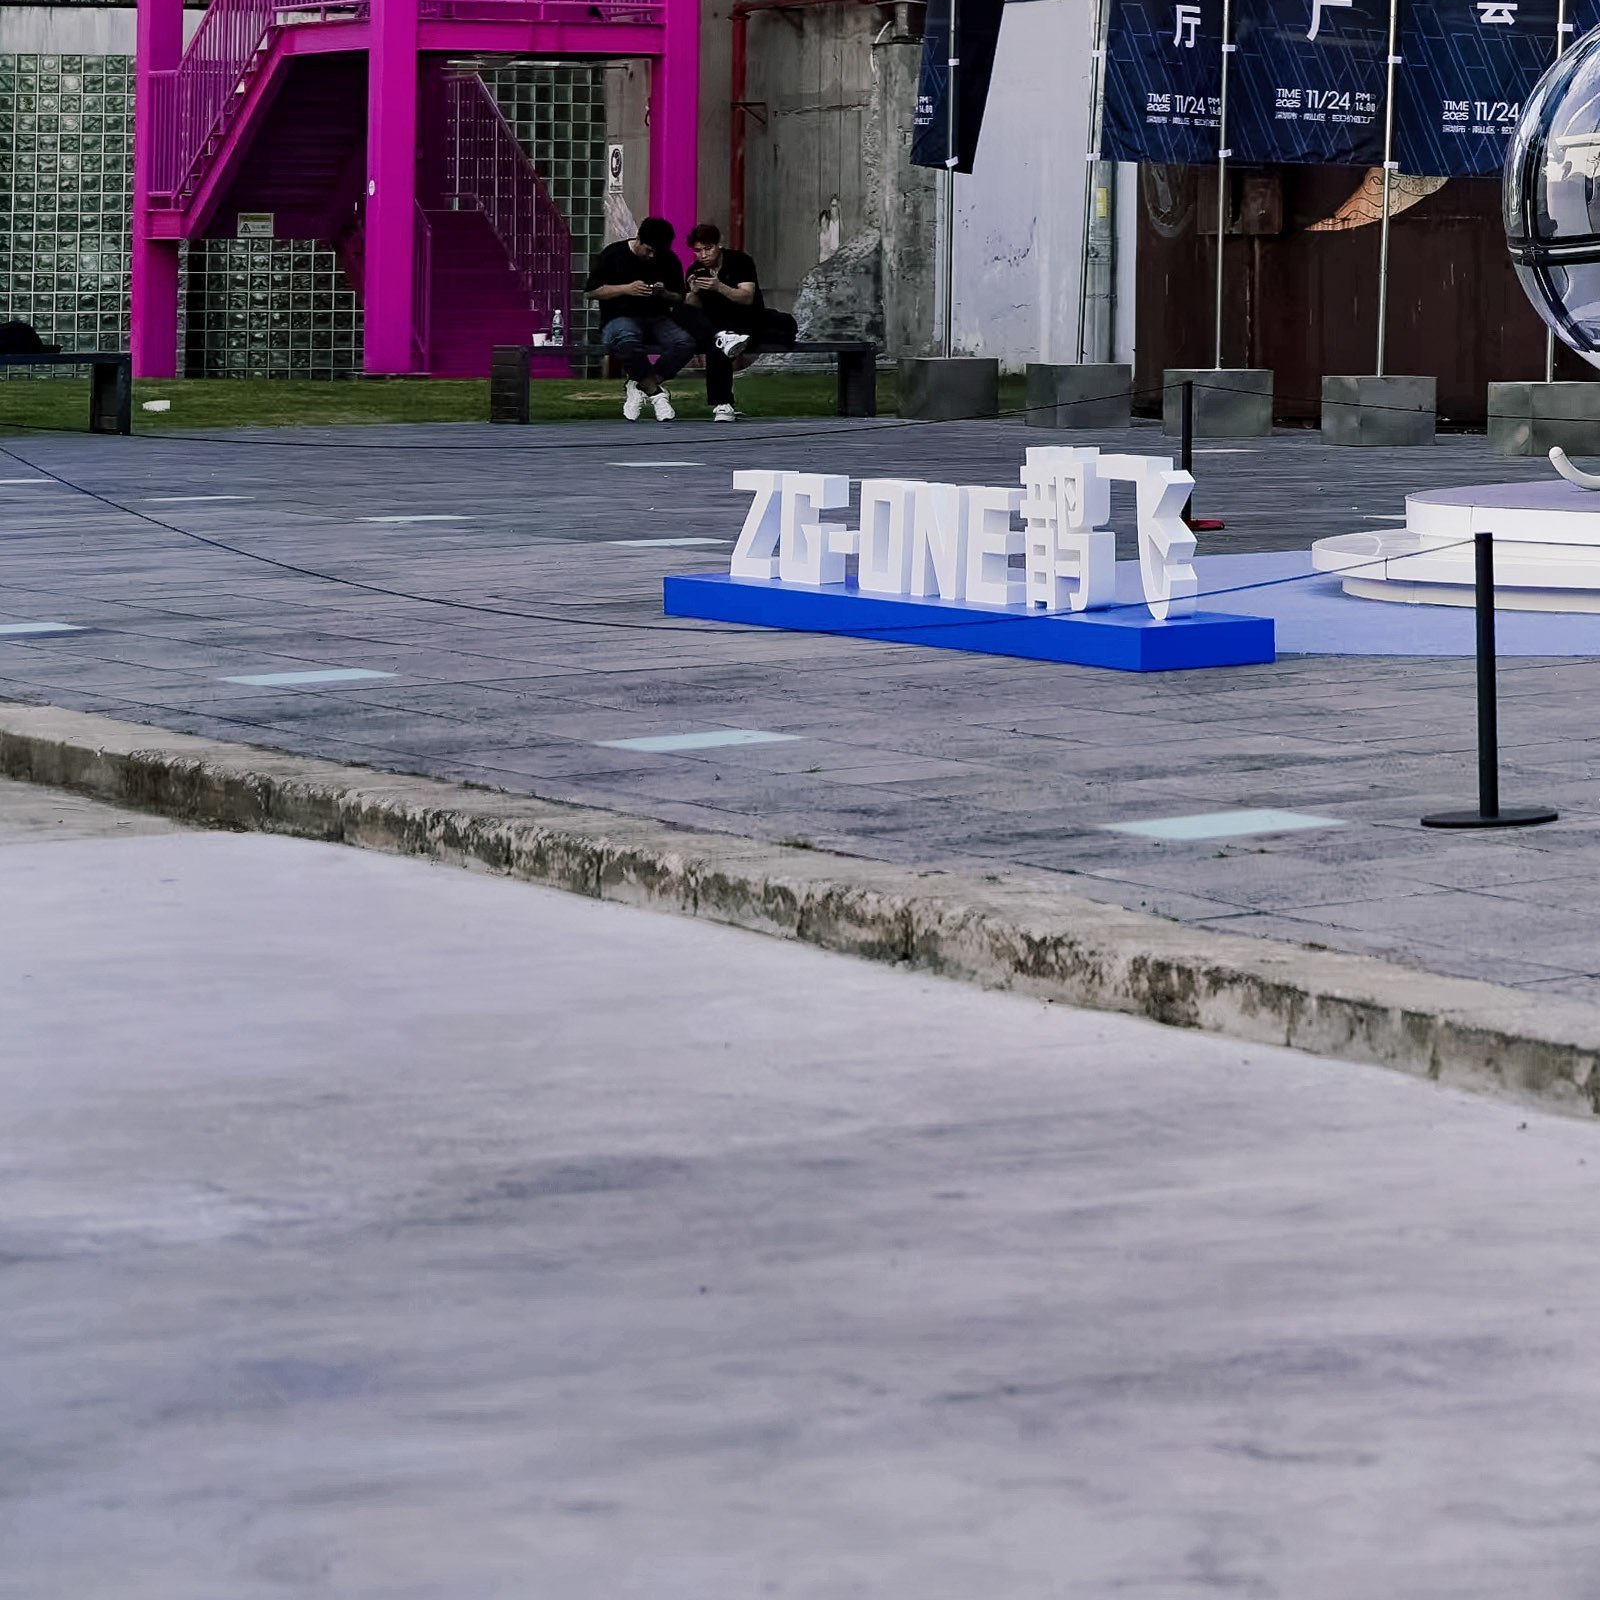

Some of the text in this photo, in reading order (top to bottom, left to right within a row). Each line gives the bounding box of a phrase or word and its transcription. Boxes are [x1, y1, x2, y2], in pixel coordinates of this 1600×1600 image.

[1147, 92, 1171, 103] TIME
[1174, 94, 1206, 114] 11/24
[1275, 88, 1302, 99] TIME
[1305, 89, 1351, 111] 11/24
[1275, 99, 1302, 108] 2025
[1442, 111, 1470, 121] 2025
[1443, 100, 1520, 122] TIME 11/24
